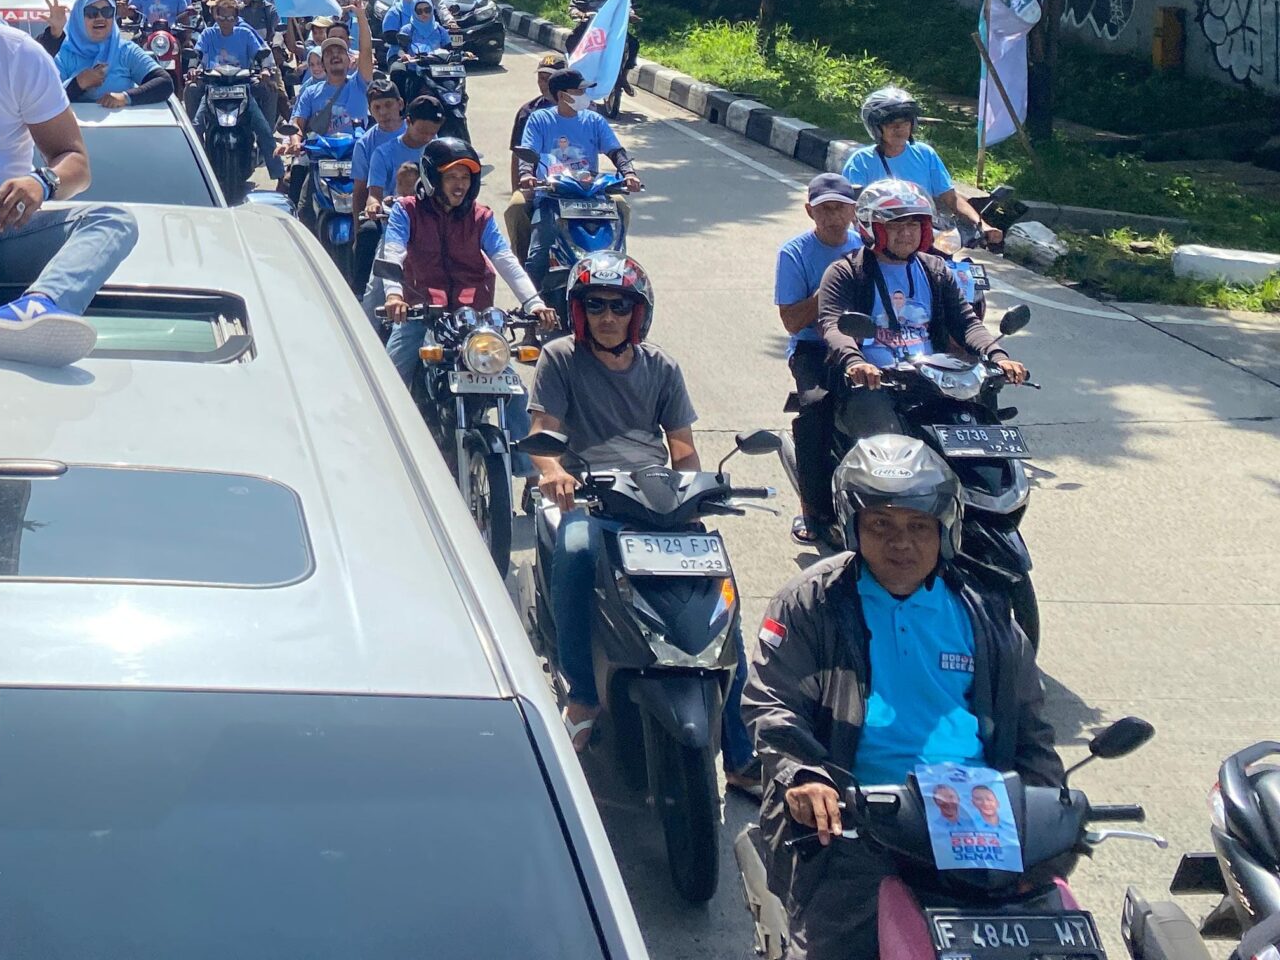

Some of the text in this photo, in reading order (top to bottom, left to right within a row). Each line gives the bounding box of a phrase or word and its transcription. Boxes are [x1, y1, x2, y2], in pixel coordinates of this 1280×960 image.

[938, 429, 1017, 441] F 6738 PP
[625, 539, 635, 553] F
[645, 539, 682, 553] 5129
[951, 845, 1004, 854] DEDIE
[954, 852, 1005, 862] JENAL
[939, 922, 1088, 949] F 4840 MT
